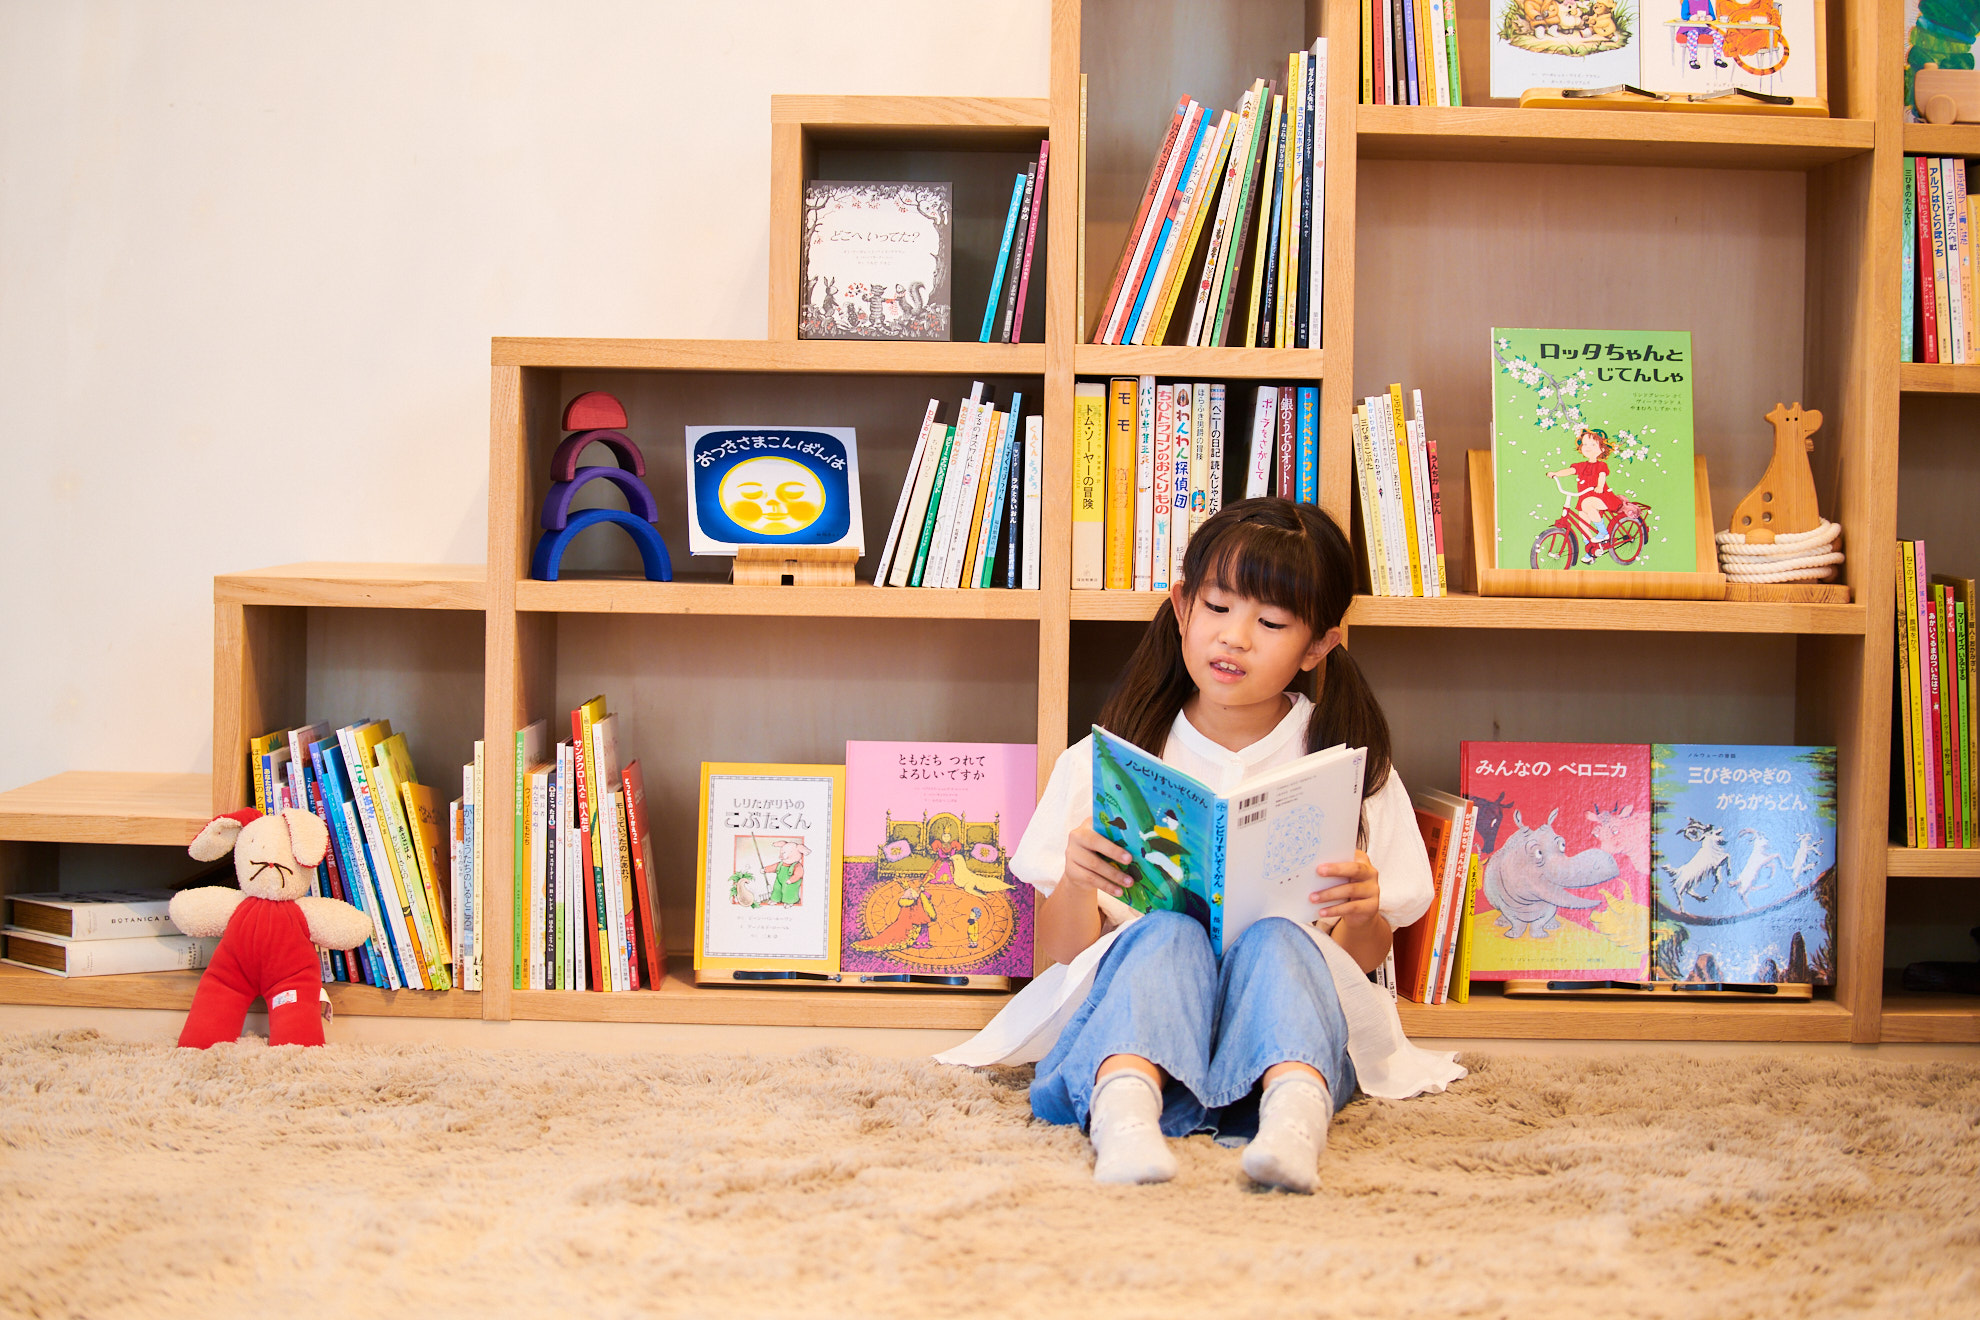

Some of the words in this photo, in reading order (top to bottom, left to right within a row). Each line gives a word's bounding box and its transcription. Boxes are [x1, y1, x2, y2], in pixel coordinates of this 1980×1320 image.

[1296, 106, 1305, 167] きつねのホイティ
[1020, 206, 1031, 221] かめ
[1904, 169, 1912, 227] 三びきのたんてい
[1929, 167, 1944, 258] アルフはひとりぼっち
[830, 231, 863, 242] どこへ
[1540, 344, 1684, 362] ロッタちゃんと
[1598, 368, 1684, 382] じてんしゃ
[1117, 392, 1131, 432] モモ
[1210, 404, 1222, 458] ペニーの日記
[695, 435, 847, 471] おつきさまこんばんは
[1029, 425, 1038, 456] くんくん
[1082, 404, 1095, 510] トム・ソーヤーの冒険
[1155, 390, 1172, 514] ちびドラゴンのおくりもの
[1174, 409, 1190, 508] わんわん探偵団
[1256, 397, 1273, 481] ポーラをさがして
[1281, 397, 1293, 497] 銀のうでのオットー
[1303, 401, 1313, 504] マイ・ベスト・フレンド
[1360, 418, 1374, 470] 三びきのこぶた
[1009, 477, 1019, 524] ラチとらいおん
[1928, 611, 1938, 695] あかいくるまのついたはこ
[899, 753, 942, 766] ともだち
[949, 754, 986, 767] つれて
[899, 768, 985, 781] よろしいですか
[1125, 760, 1208, 809] ノンビリすいぞくかん
[1475, 760, 1551, 778] みんなの
[1558, 762, 1628, 779] ベロニカ
[1688, 767, 1792, 785] 三びきのやぎの
[574, 740, 586, 798] サンタクロースと
[580, 801, 589, 832] 小人たち
[733, 798, 805, 810] しりたがりやの
[1716, 792, 1808, 811] がらがらどん
[724, 811, 813, 830] こぶたくん
[463, 806, 473, 928] かいじゅうたちのいるところ
[1214, 814, 1224, 888] ノンビリすいぞくかん
[1468, 864, 1479, 917] くまのテディちゃん
[111, 916, 159, 924] BOTANICA
